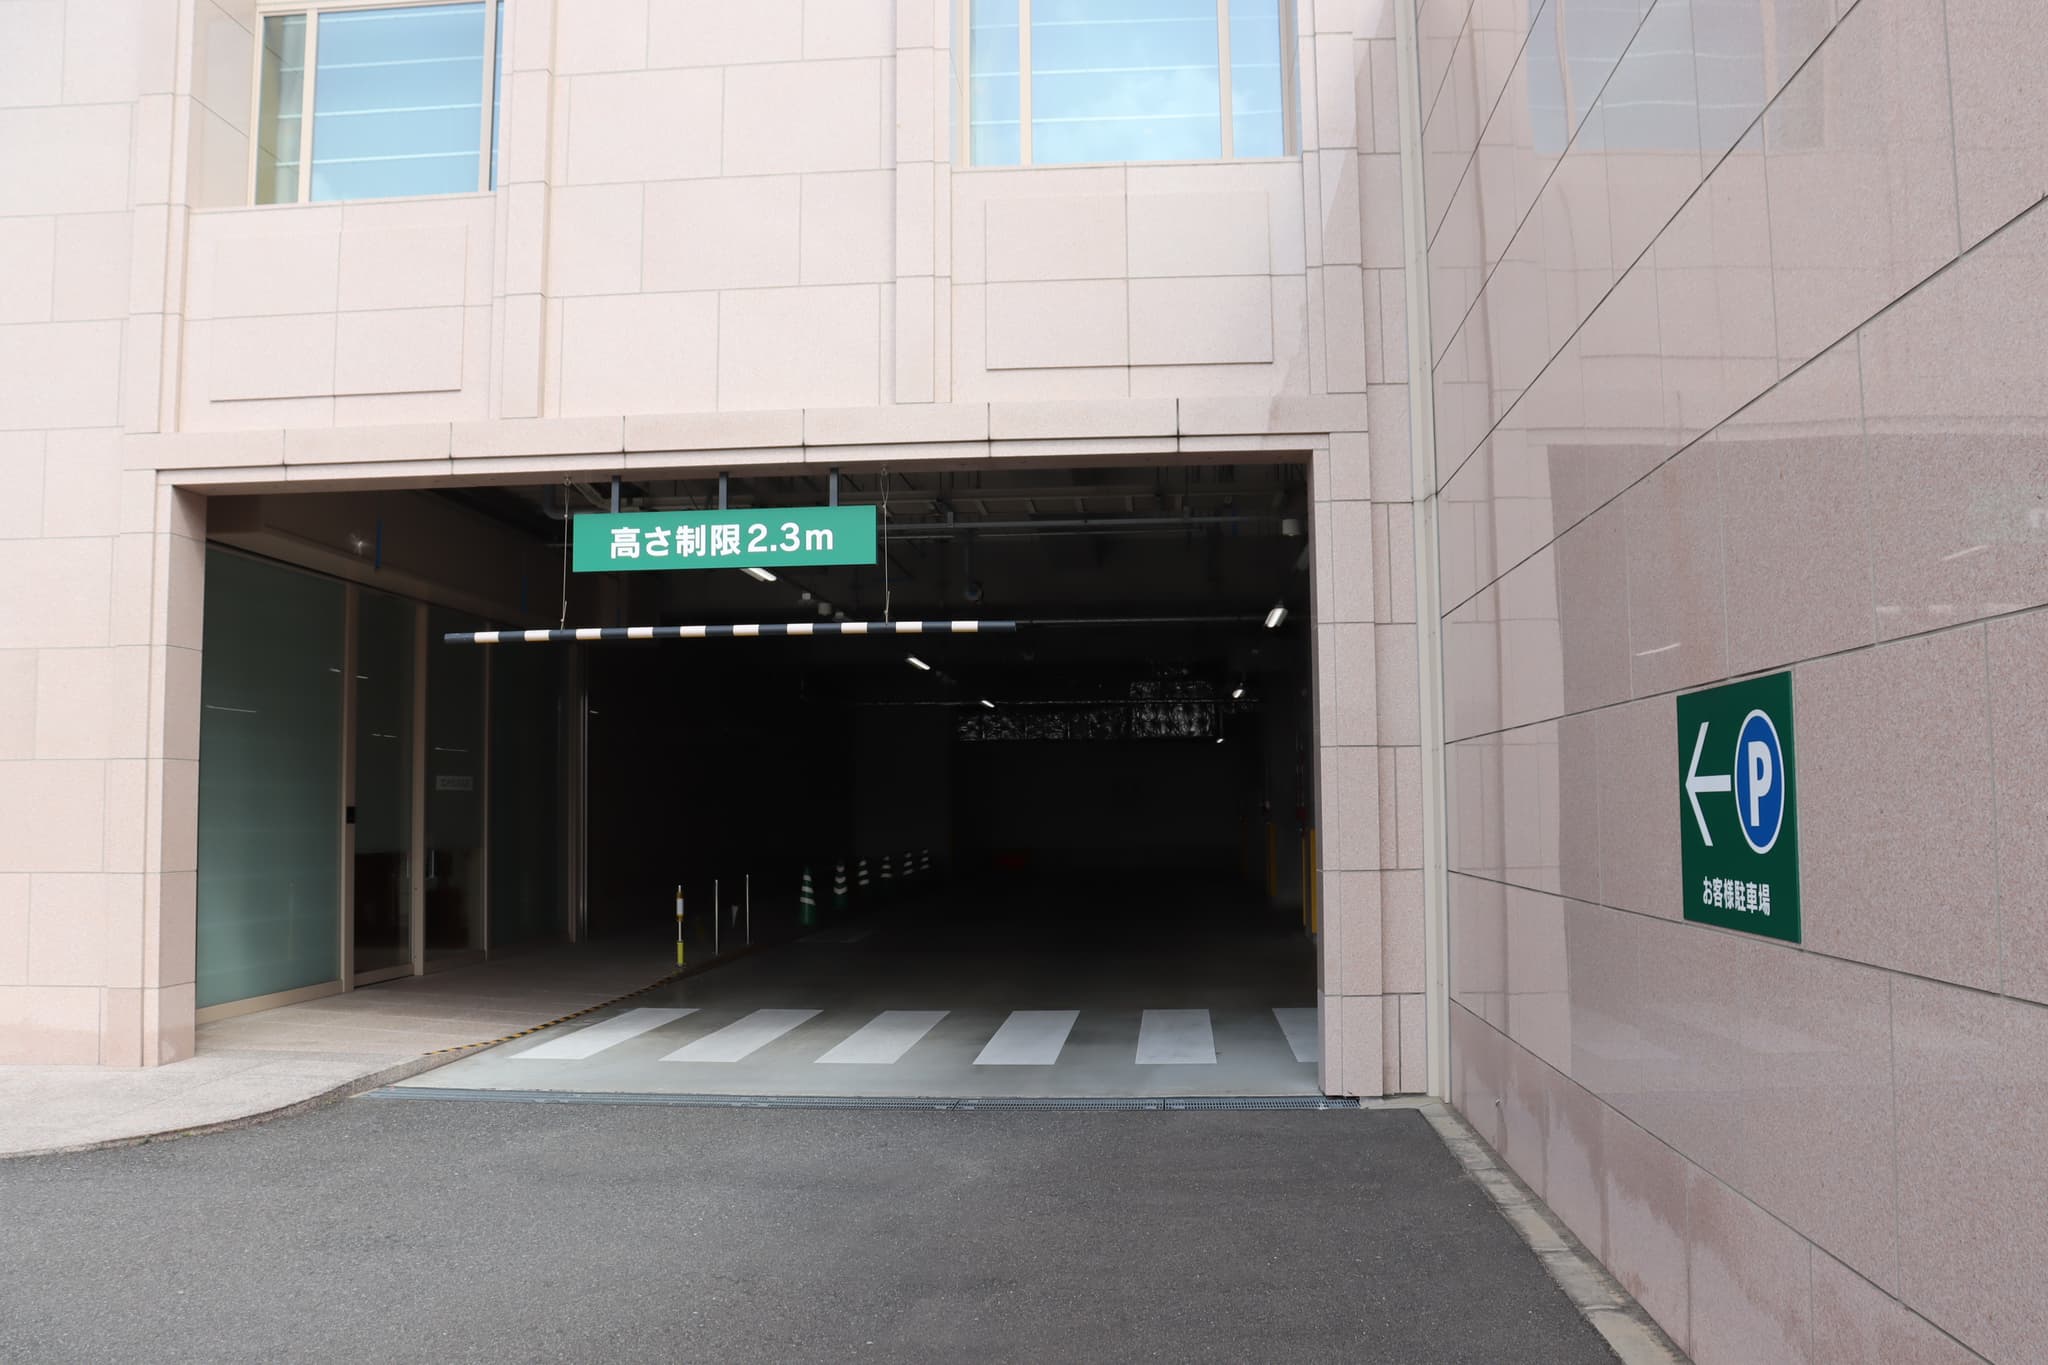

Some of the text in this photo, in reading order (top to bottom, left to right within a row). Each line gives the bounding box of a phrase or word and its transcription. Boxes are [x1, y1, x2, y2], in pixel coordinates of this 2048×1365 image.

[610, 522, 834, 559] 高さ制限2.3m
[1748, 741, 1773, 827] P
[1703, 876, 1771, 916] お客様駐車場
